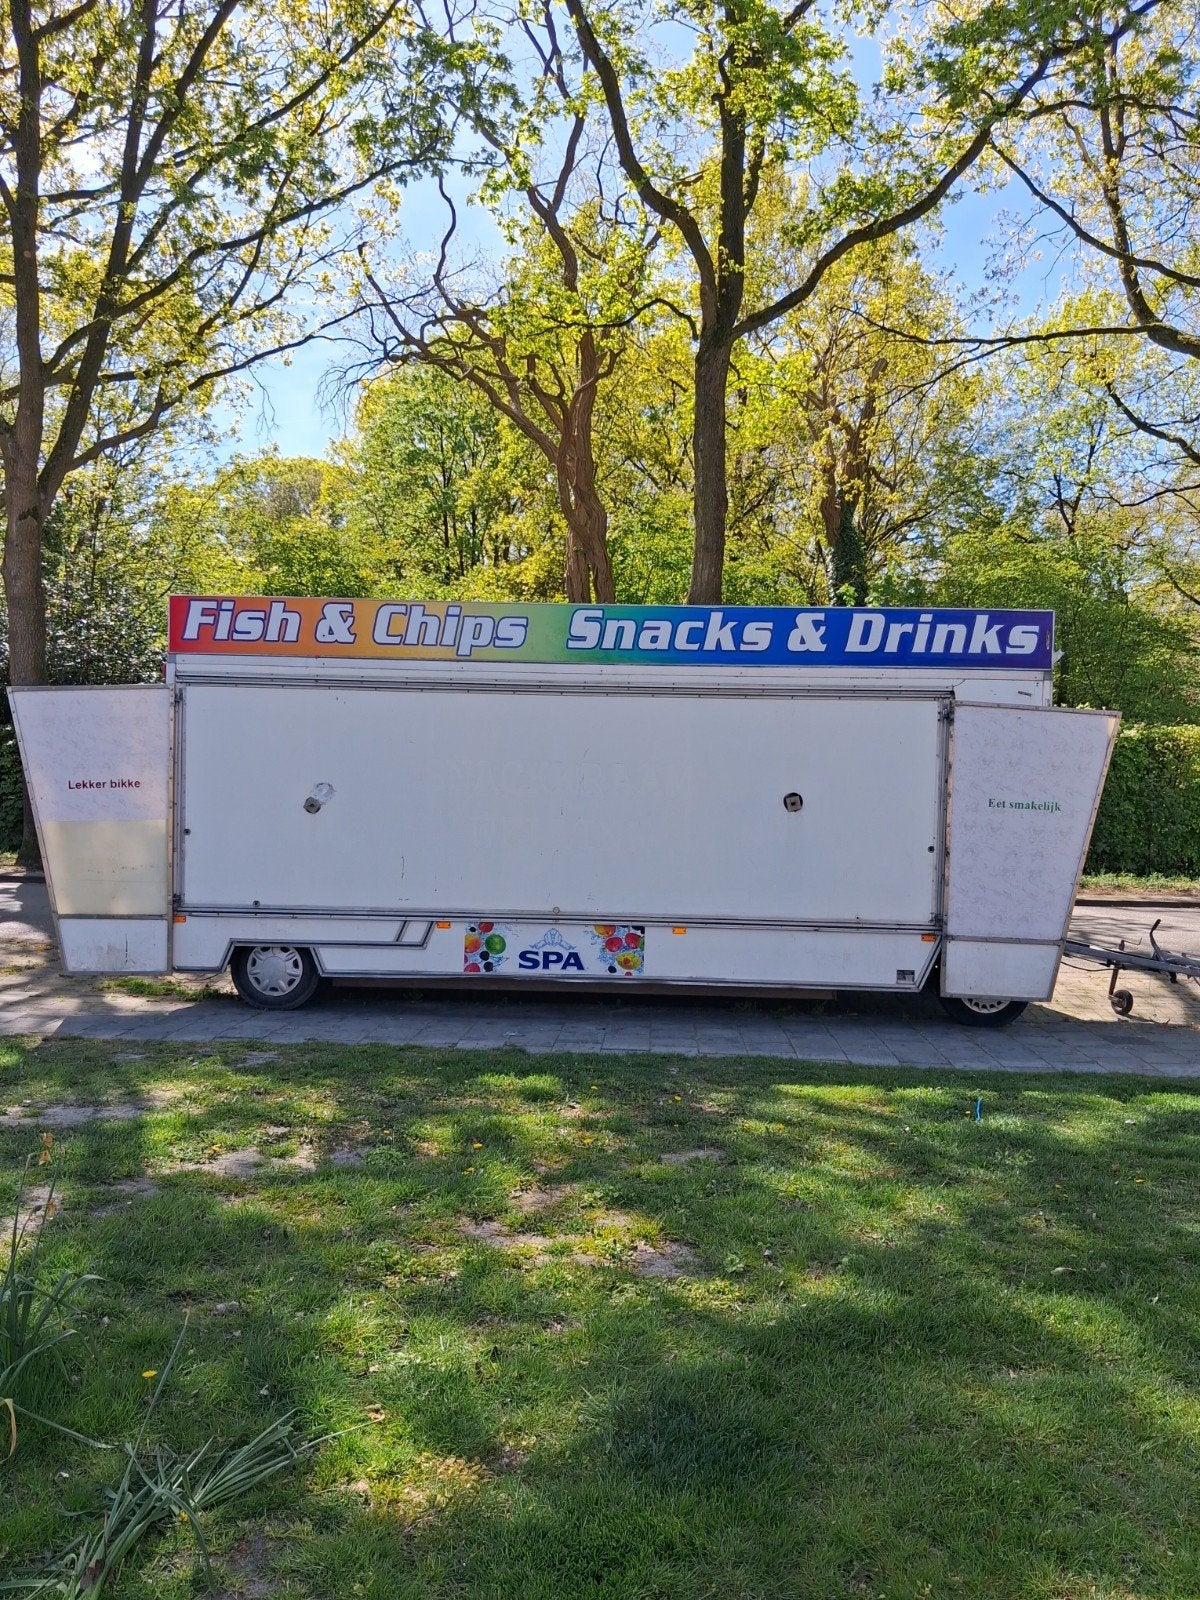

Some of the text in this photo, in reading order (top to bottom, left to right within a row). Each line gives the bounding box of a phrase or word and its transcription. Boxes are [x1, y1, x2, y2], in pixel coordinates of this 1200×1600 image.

[182, 600, 1041, 656] Fish & Chips Snacks & Drinks
[68, 779, 141, 790] Lekker bikke
[988, 798, 1062, 813] Eet smakelijk
[518, 950, 586, 971] SPA
